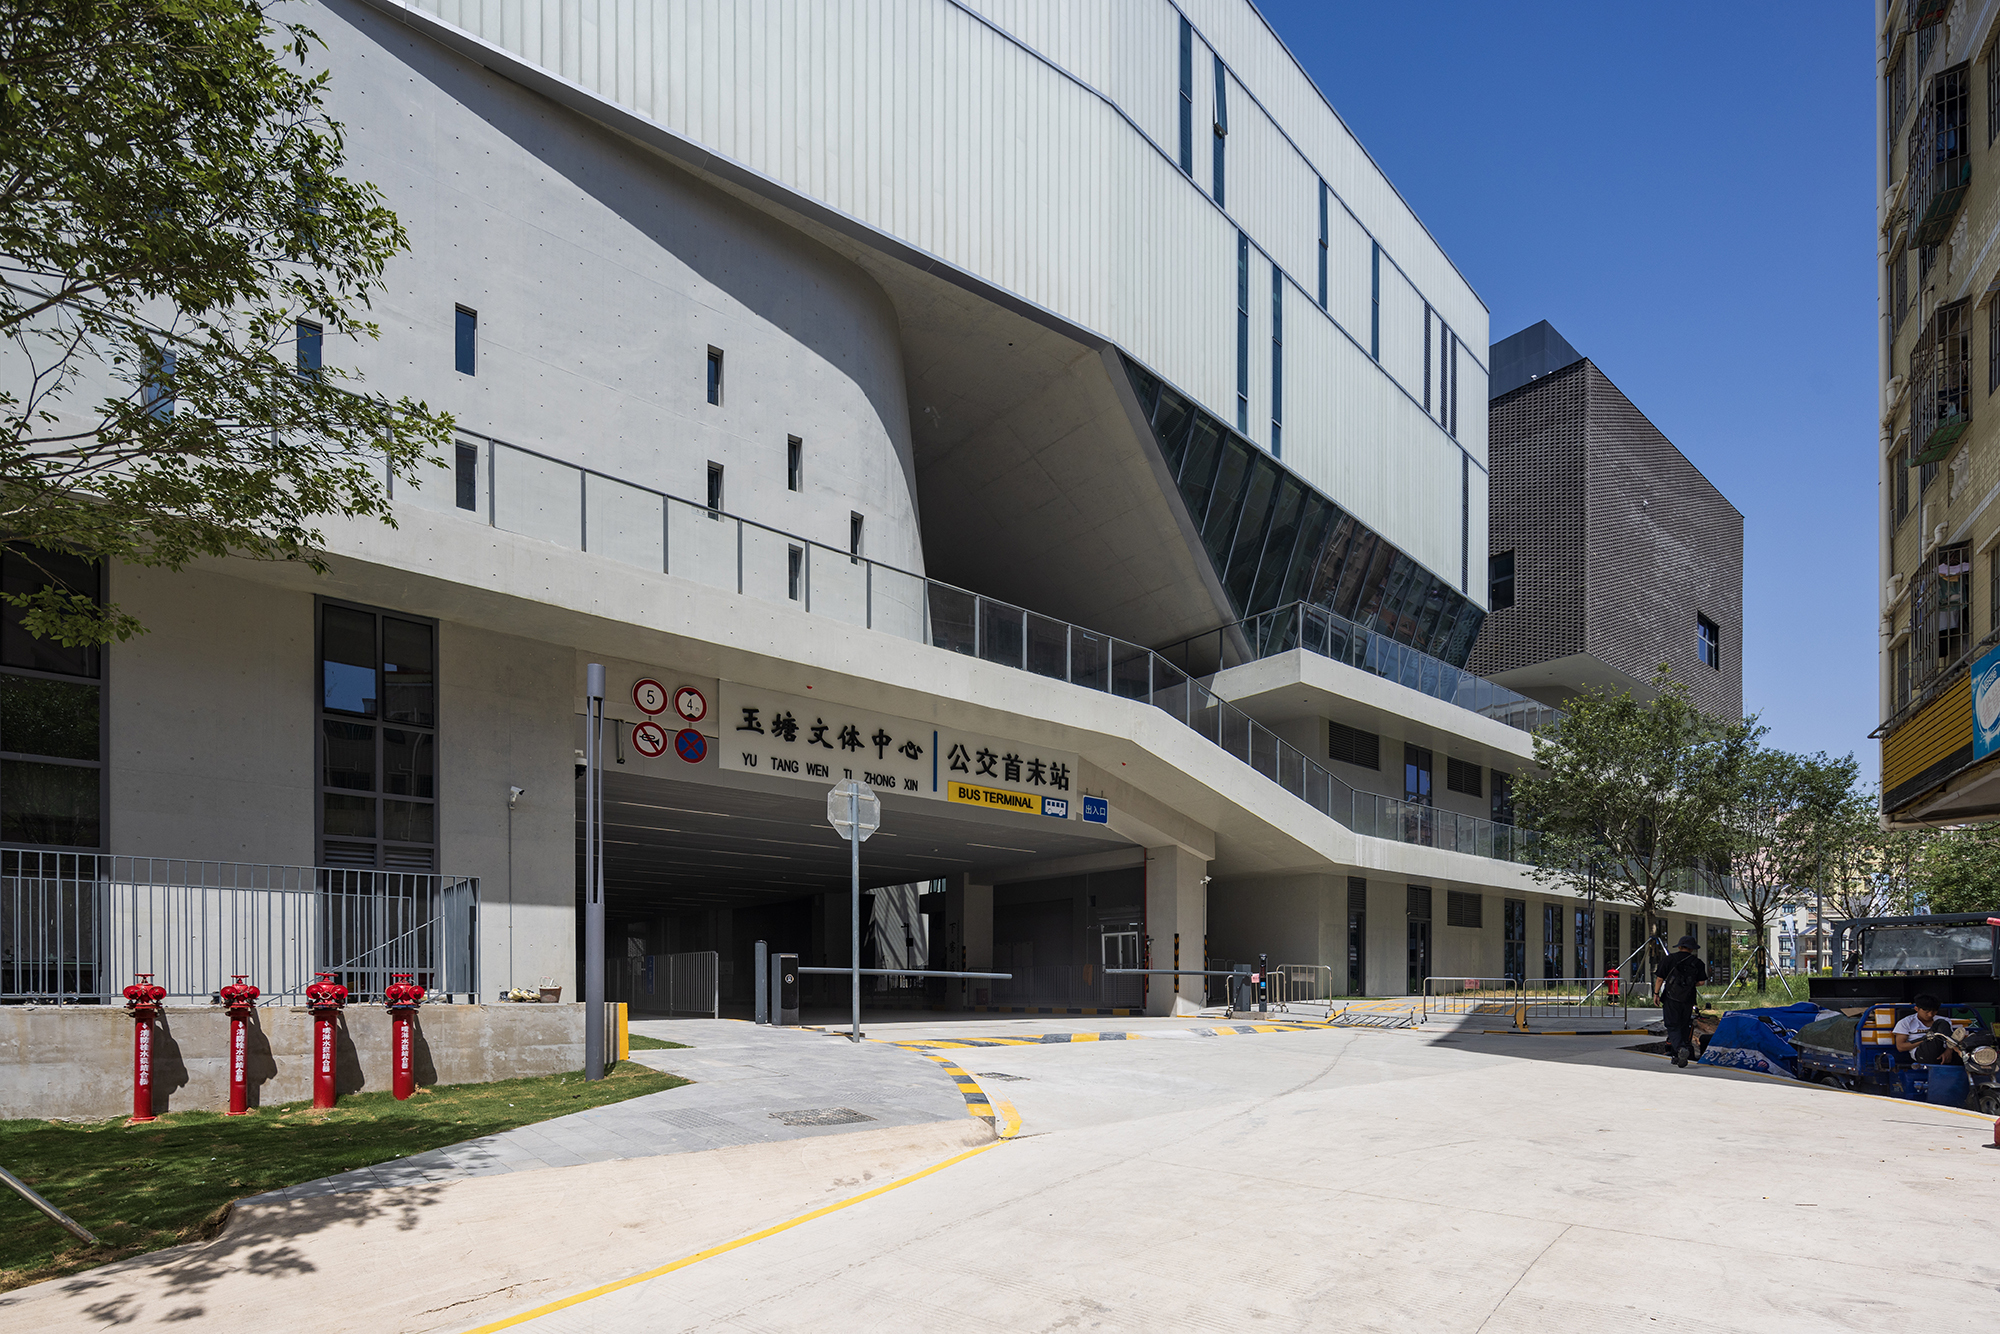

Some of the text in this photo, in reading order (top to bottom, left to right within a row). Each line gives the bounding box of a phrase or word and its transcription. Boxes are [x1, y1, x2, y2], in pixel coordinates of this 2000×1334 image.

[646, 689, 656, 705] 5
[736, 708, 923, 760] 玉塘文体中心
[742, 752, 757, 767] YU
[771, 757, 799, 773] TANG
[806, 762, 829, 777] WEN
[864, 771, 896, 788] ZHONG
[903, 778, 918, 791] XIN
[947, 743, 1071, 791] 公交首末站
[958, 787, 1034, 809] BUS TERMINAL
[1085, 804, 1107, 817] 出入口
